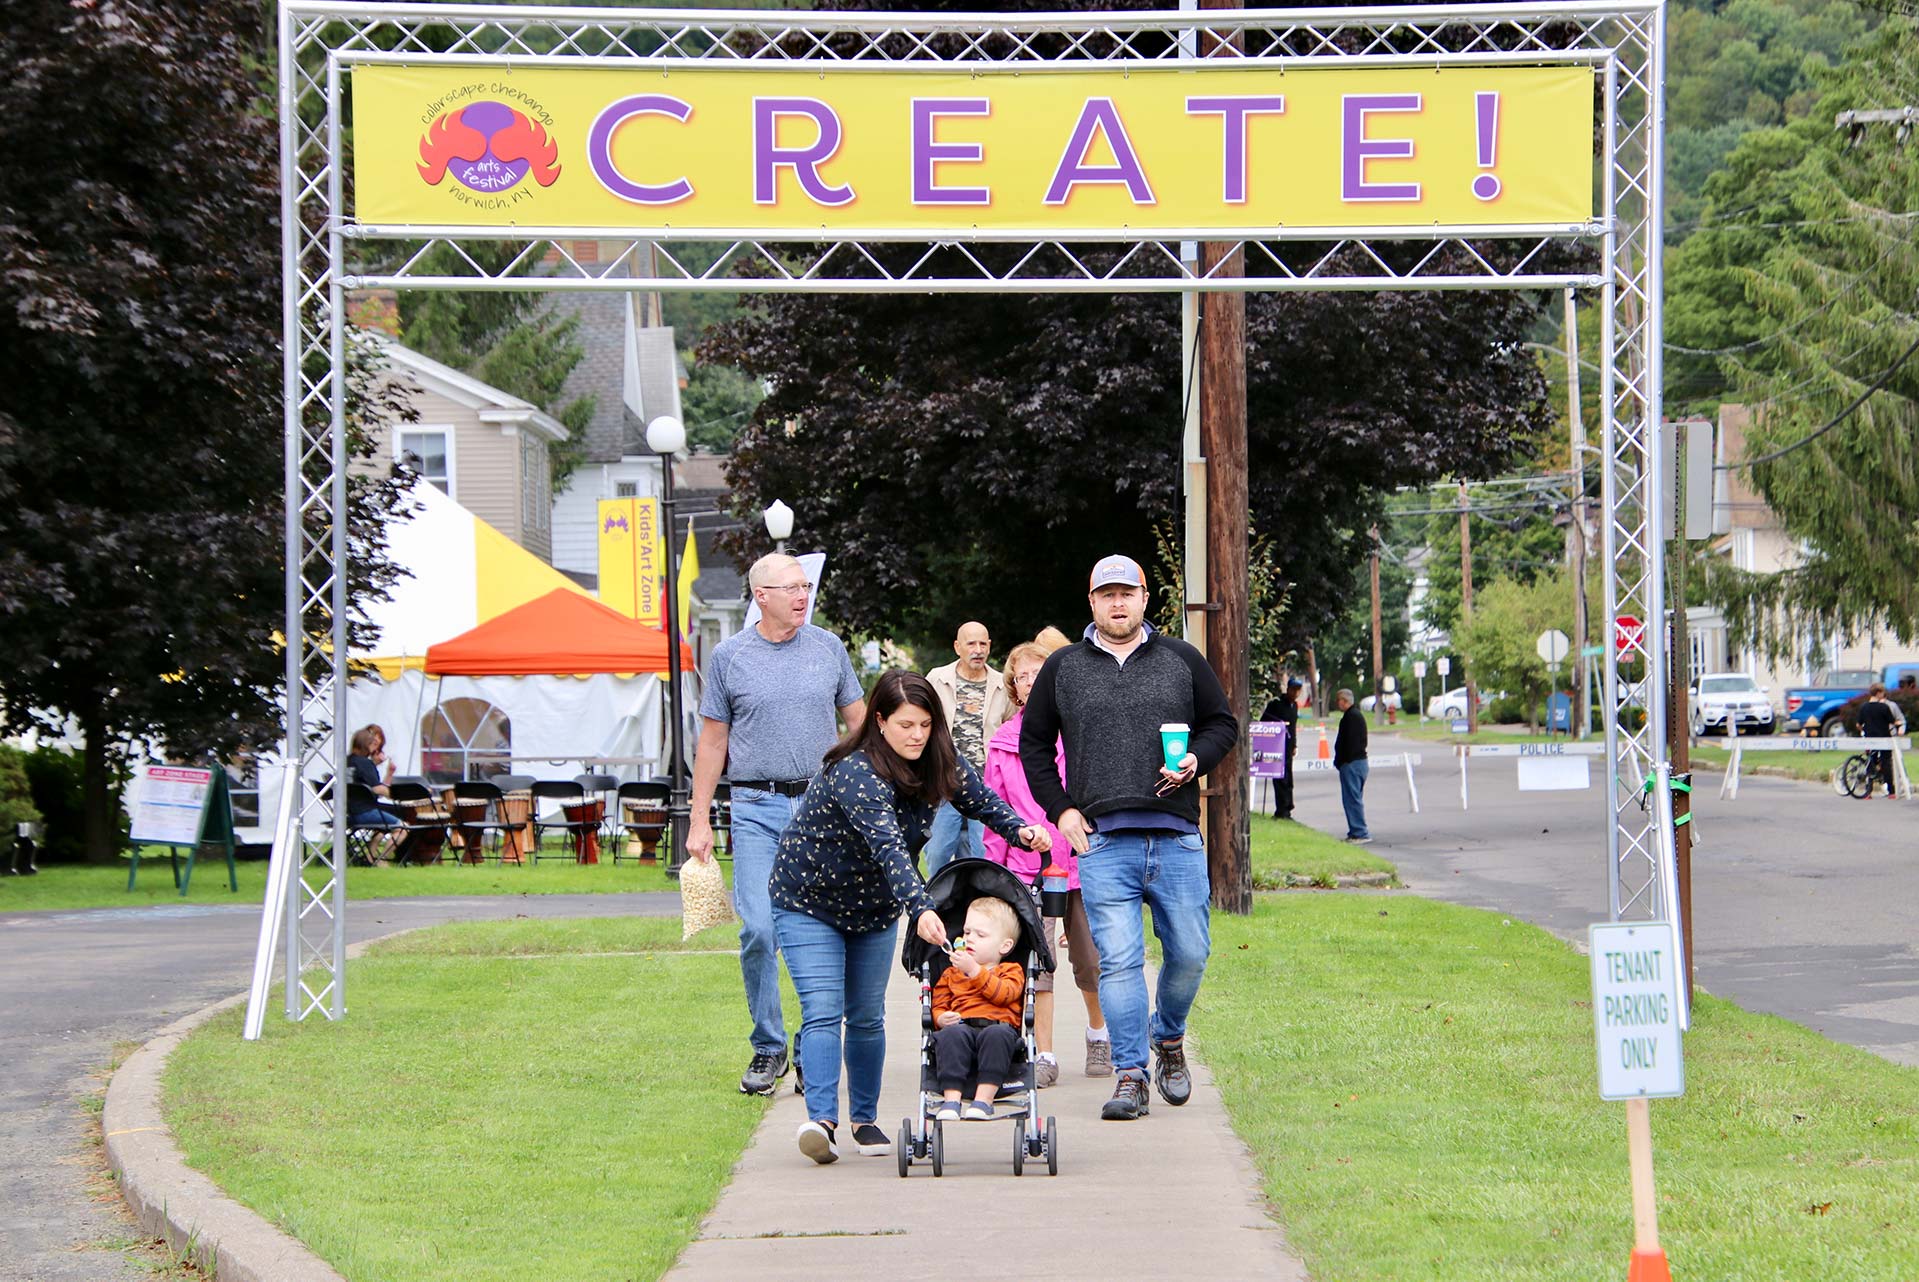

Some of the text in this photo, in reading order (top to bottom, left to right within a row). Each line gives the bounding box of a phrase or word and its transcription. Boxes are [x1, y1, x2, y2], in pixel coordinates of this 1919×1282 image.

[586, 91, 1501, 206] CREATE!
[462, 166, 517, 189] festival
[477, 159, 499, 172] arts
[640, 545, 653, 571] Art
[641, 576, 653, 613] Zone
[1520, 743, 1565, 756] POLICE
[1793, 740, 1839, 749] POLICE
[1605, 951, 1661, 984] TENANT
[1605, 993, 1669, 1026] PARKING
[1621, 1037, 1658, 1070] ONLY
